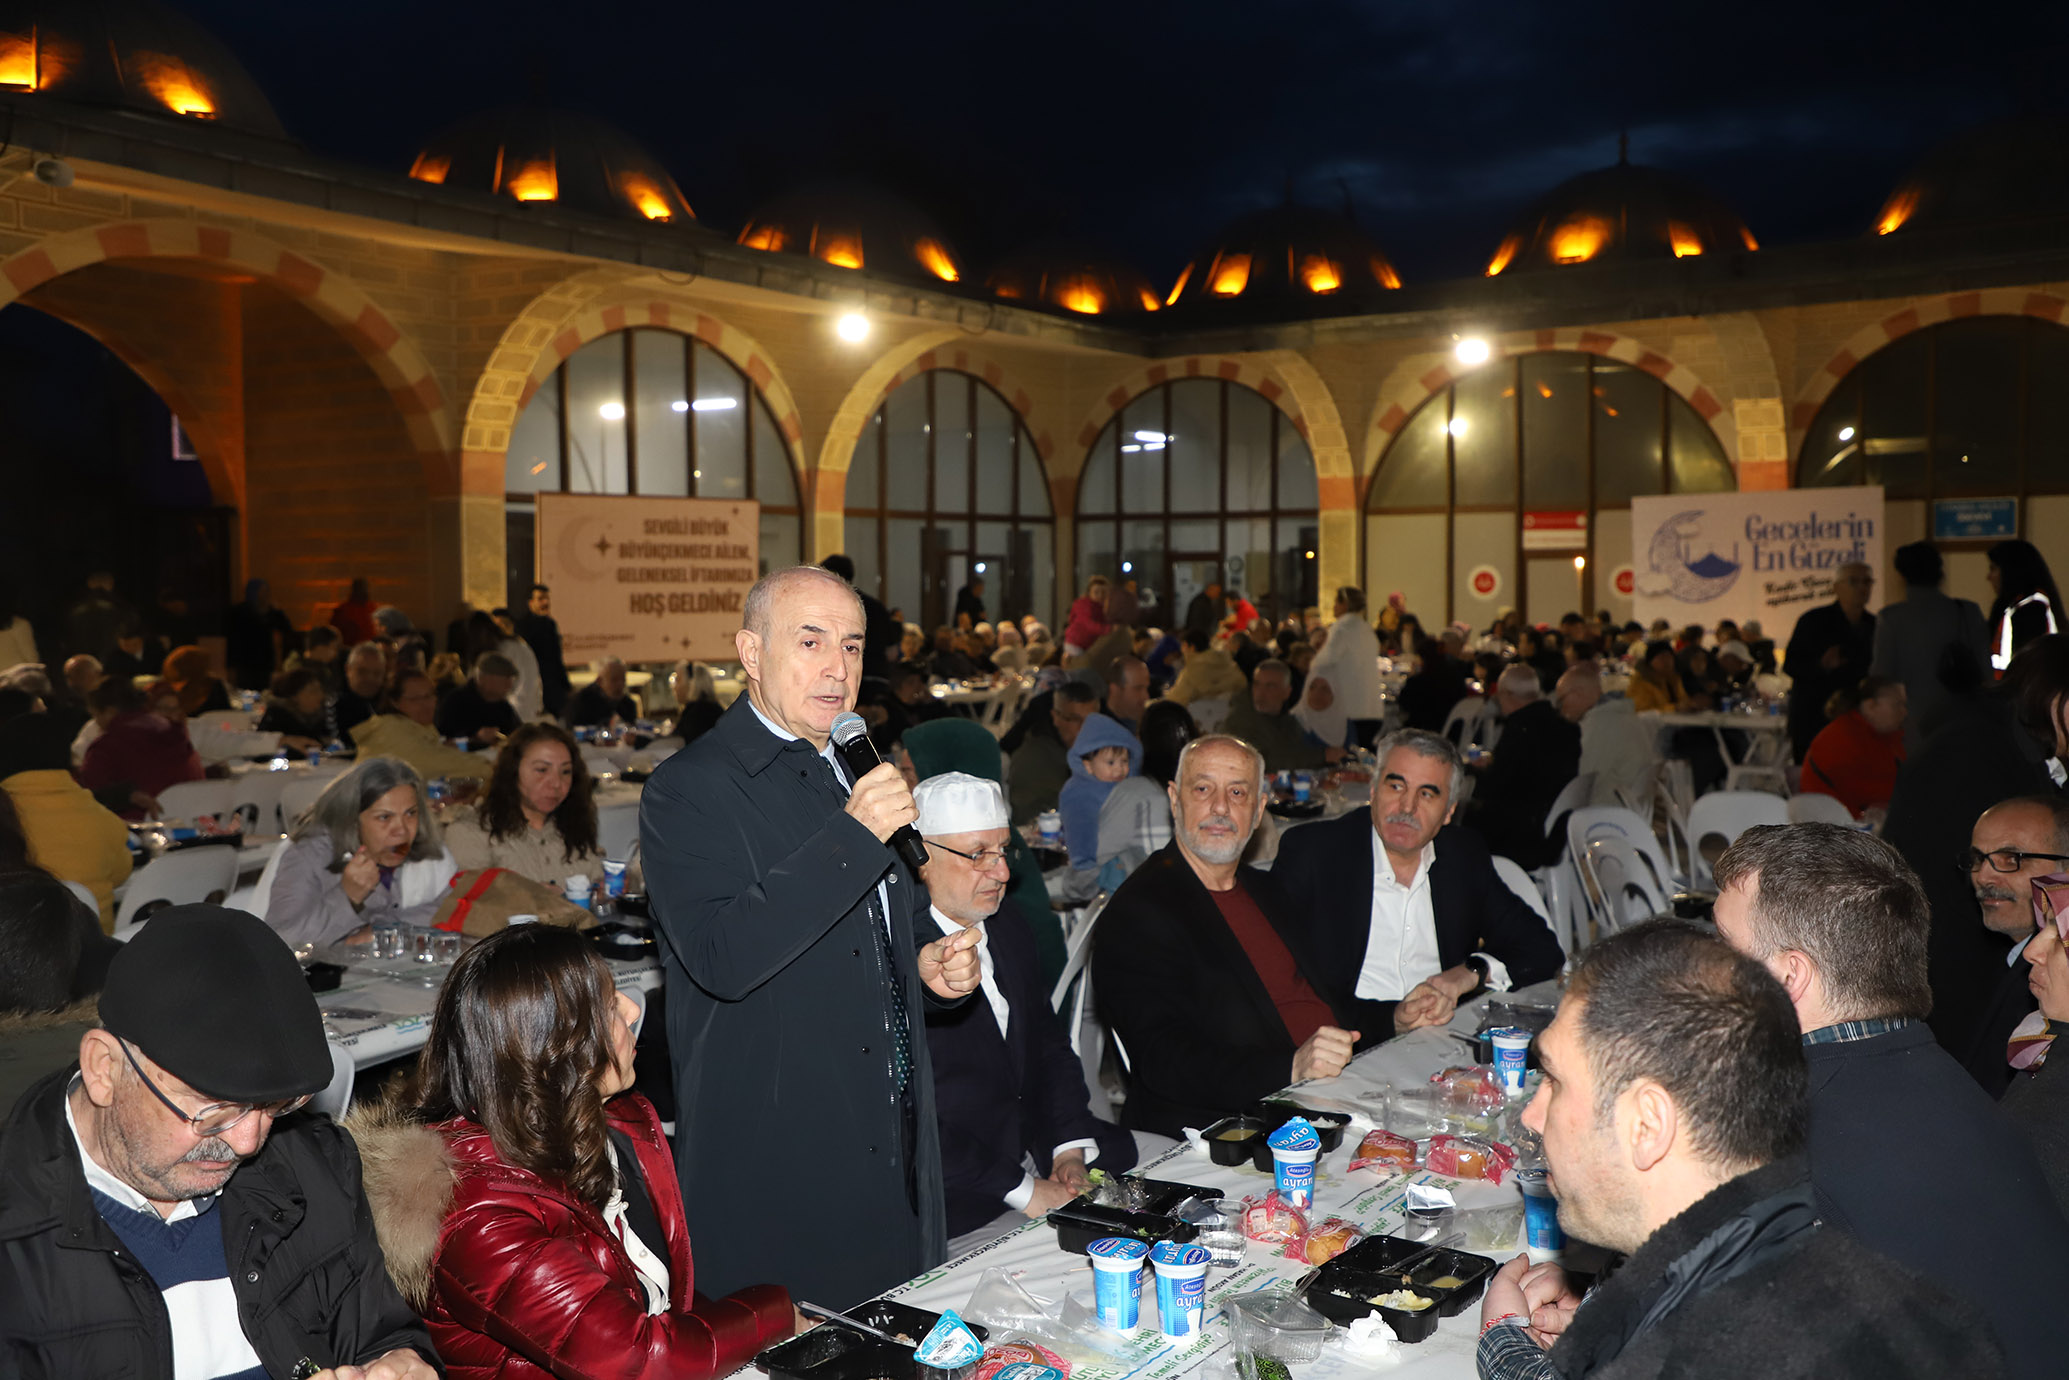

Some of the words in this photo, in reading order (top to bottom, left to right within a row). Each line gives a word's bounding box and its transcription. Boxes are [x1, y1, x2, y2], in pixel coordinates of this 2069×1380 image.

[1745, 511, 1874, 541] Gecelerin
[1753, 543, 1784, 572] En
[629, 591, 666, 619] HOŞ
[668, 588, 742, 614] GELDİNİZ
[1273, 1127, 1310, 1147] ayran
[1282, 1177, 1313, 1190] ayran
[1176, 1293, 1204, 1311] ayra
[1146, 1359, 1179, 1380] Temeli
